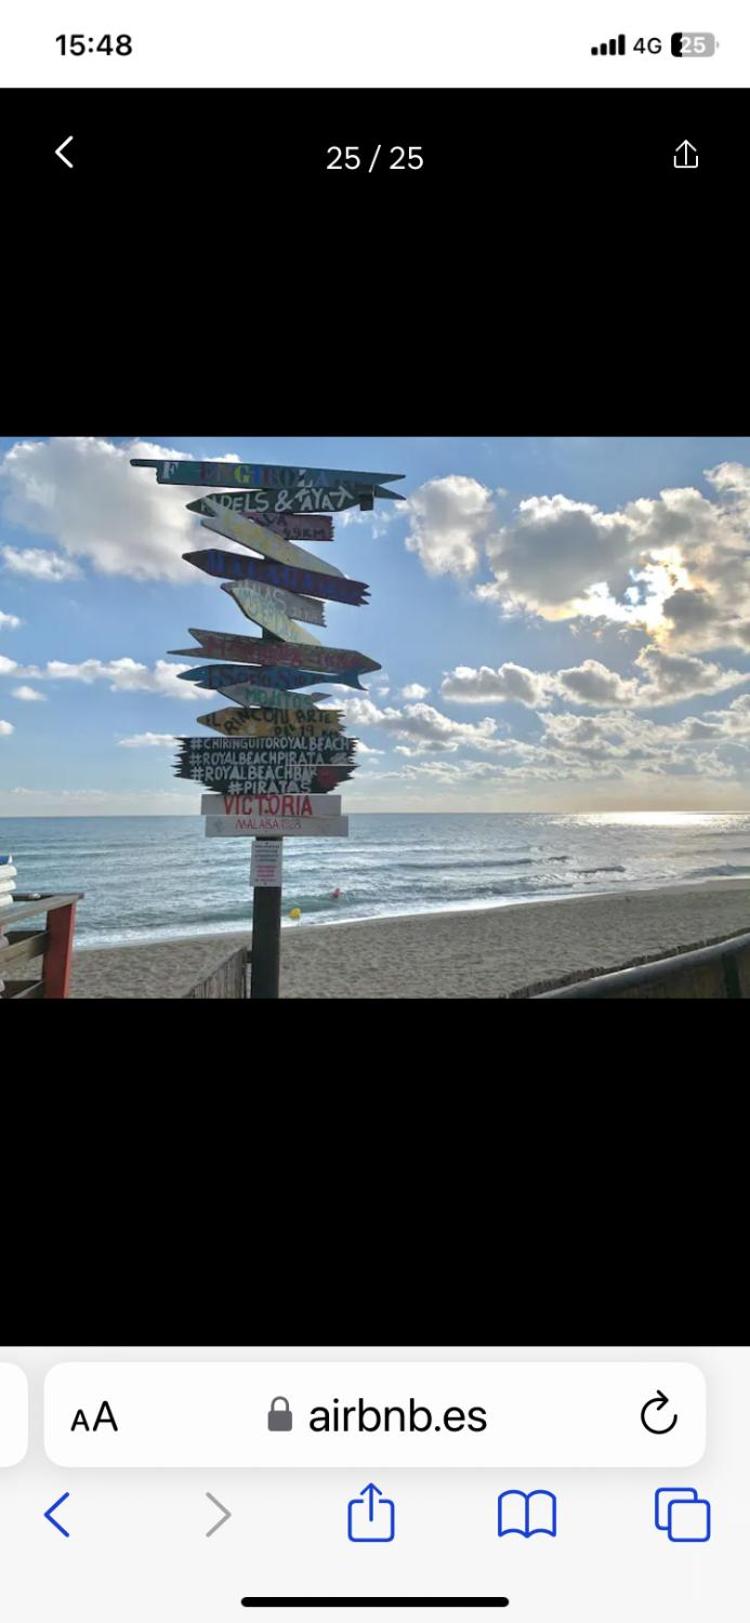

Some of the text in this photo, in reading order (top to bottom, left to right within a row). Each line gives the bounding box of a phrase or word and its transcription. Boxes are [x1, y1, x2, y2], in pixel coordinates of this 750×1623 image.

[55, 33, 133, 57] 15:48
[632, 36, 705, 55] 4G 25
[326, 144, 424, 173] 25 / 25
[227, 780, 311, 795] #PIRATAS
[222, 794, 314, 817] VICTORIA
[309, 1397, 487, 1433] airbnb.es
